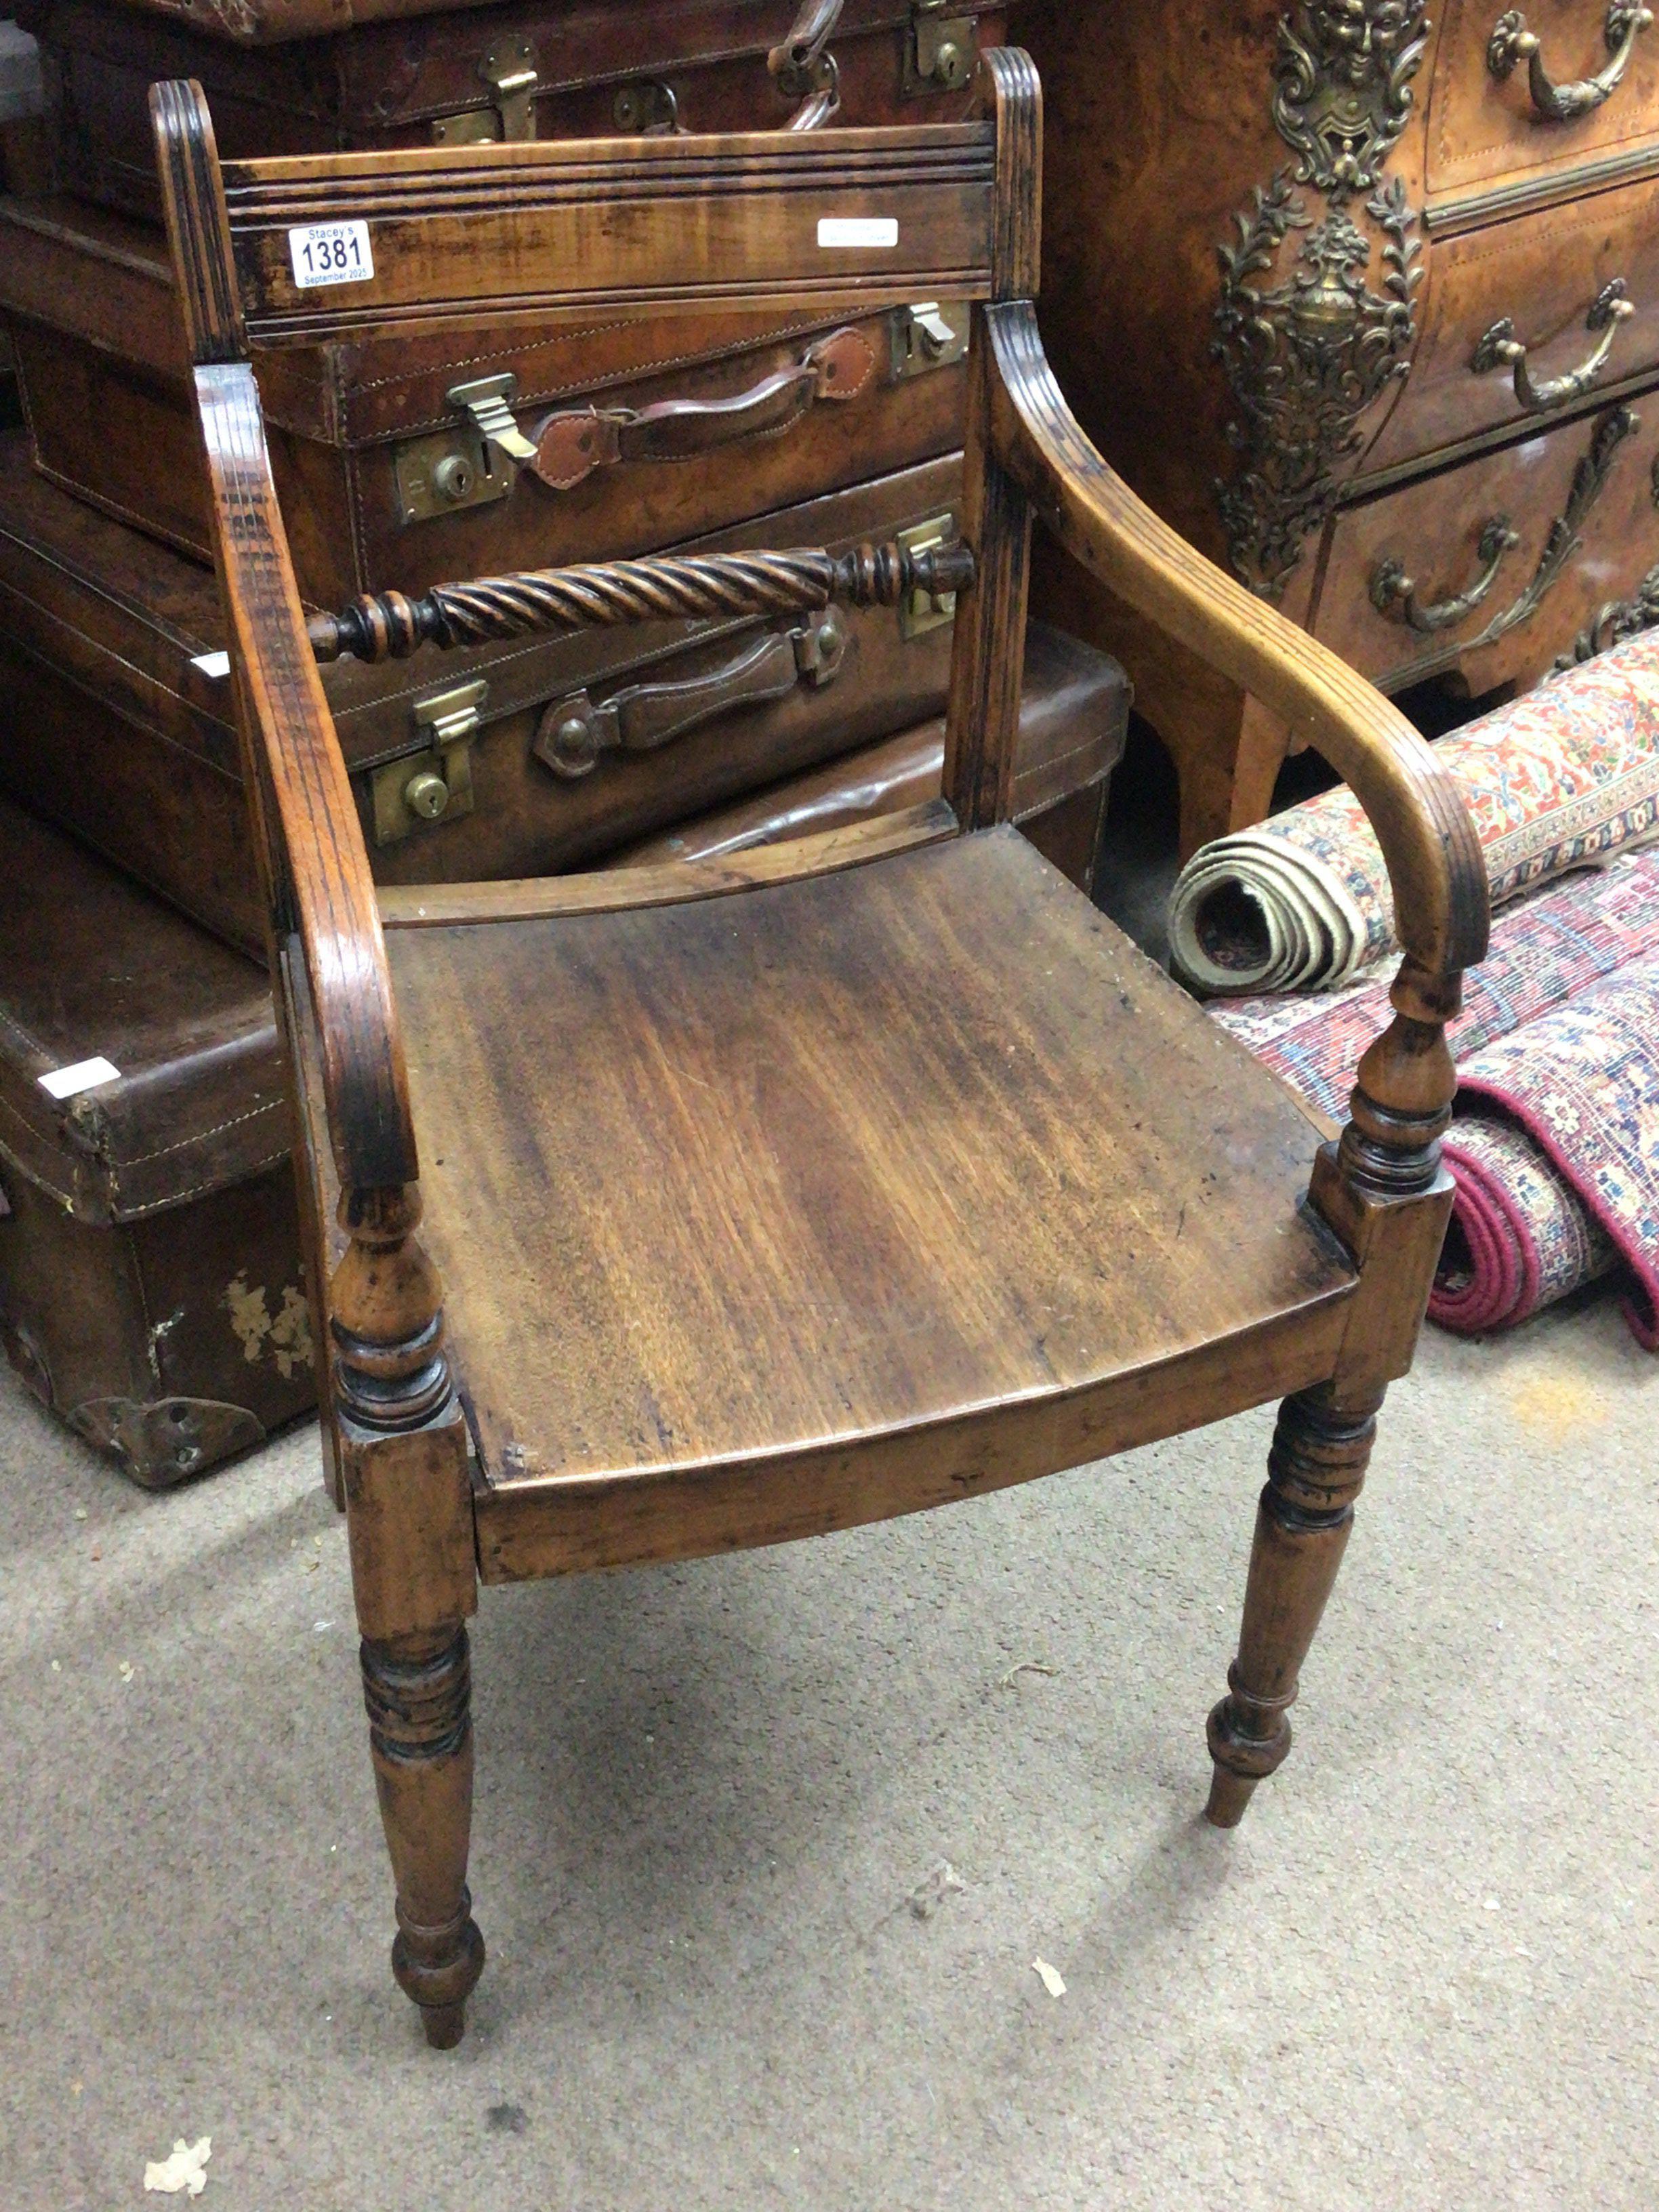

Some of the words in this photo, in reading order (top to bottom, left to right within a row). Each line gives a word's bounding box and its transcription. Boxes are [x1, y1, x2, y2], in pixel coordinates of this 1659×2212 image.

[308, 226, 354, 240] Stacey's
[302, 237, 361, 272] 1381
[304, 272, 347, 285] September
[349, 268, 367, 279] 2025
